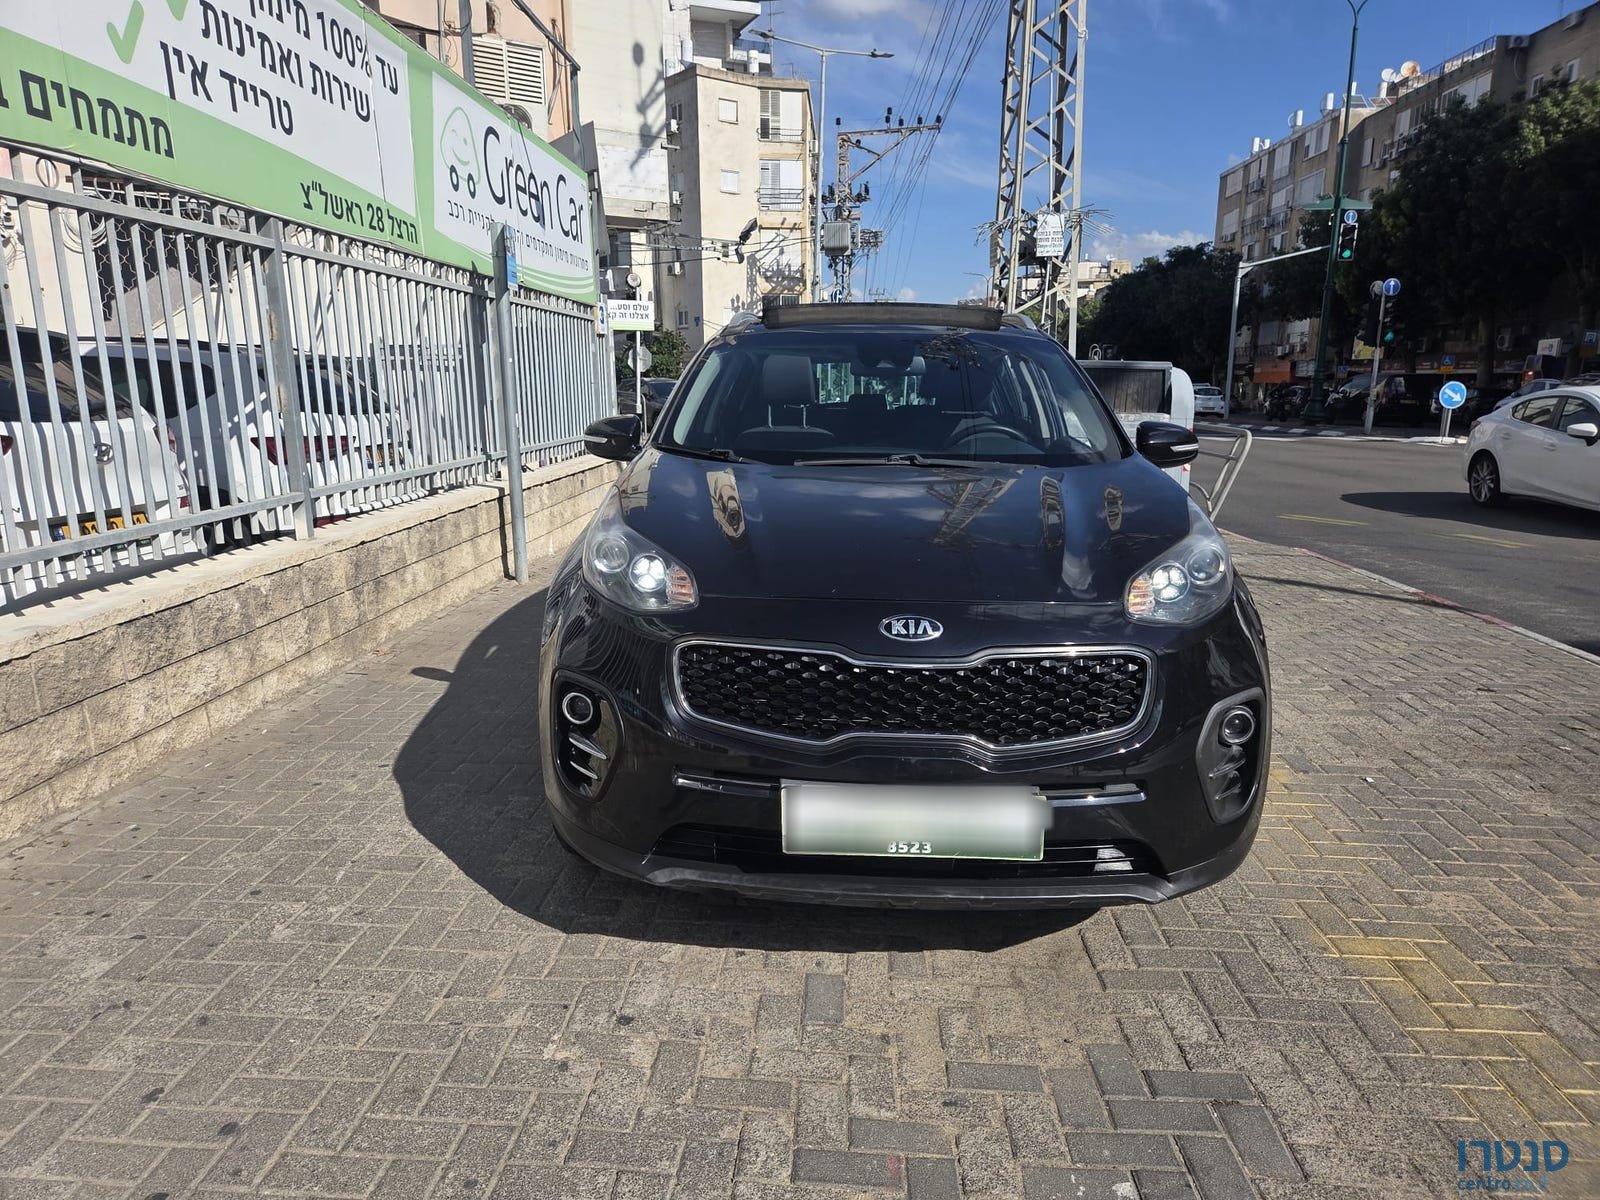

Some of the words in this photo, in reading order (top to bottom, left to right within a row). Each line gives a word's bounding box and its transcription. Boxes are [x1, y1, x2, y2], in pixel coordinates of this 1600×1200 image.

[200, 1, 303, 88] ואמינות
[317, 12, 372, 78] 100%
[160, 41, 213, 102] אין
[309, 61, 371, 122] שירות
[376, 55, 398, 95] עד
[19, 70, 174, 159] מתמחים
[219, 69, 294, 135] טרייד
[483, 126, 554, 229] Green
[556, 174, 583, 244] Car
[366, 203, 384, 232] 28
[386, 208, 418, 244] הרצל
[448, 200, 466, 221] רכב
[629, 311, 649, 319] אצלנו
[633, 303, 649, 311] שלם
[891, 619, 933, 637] KIA
